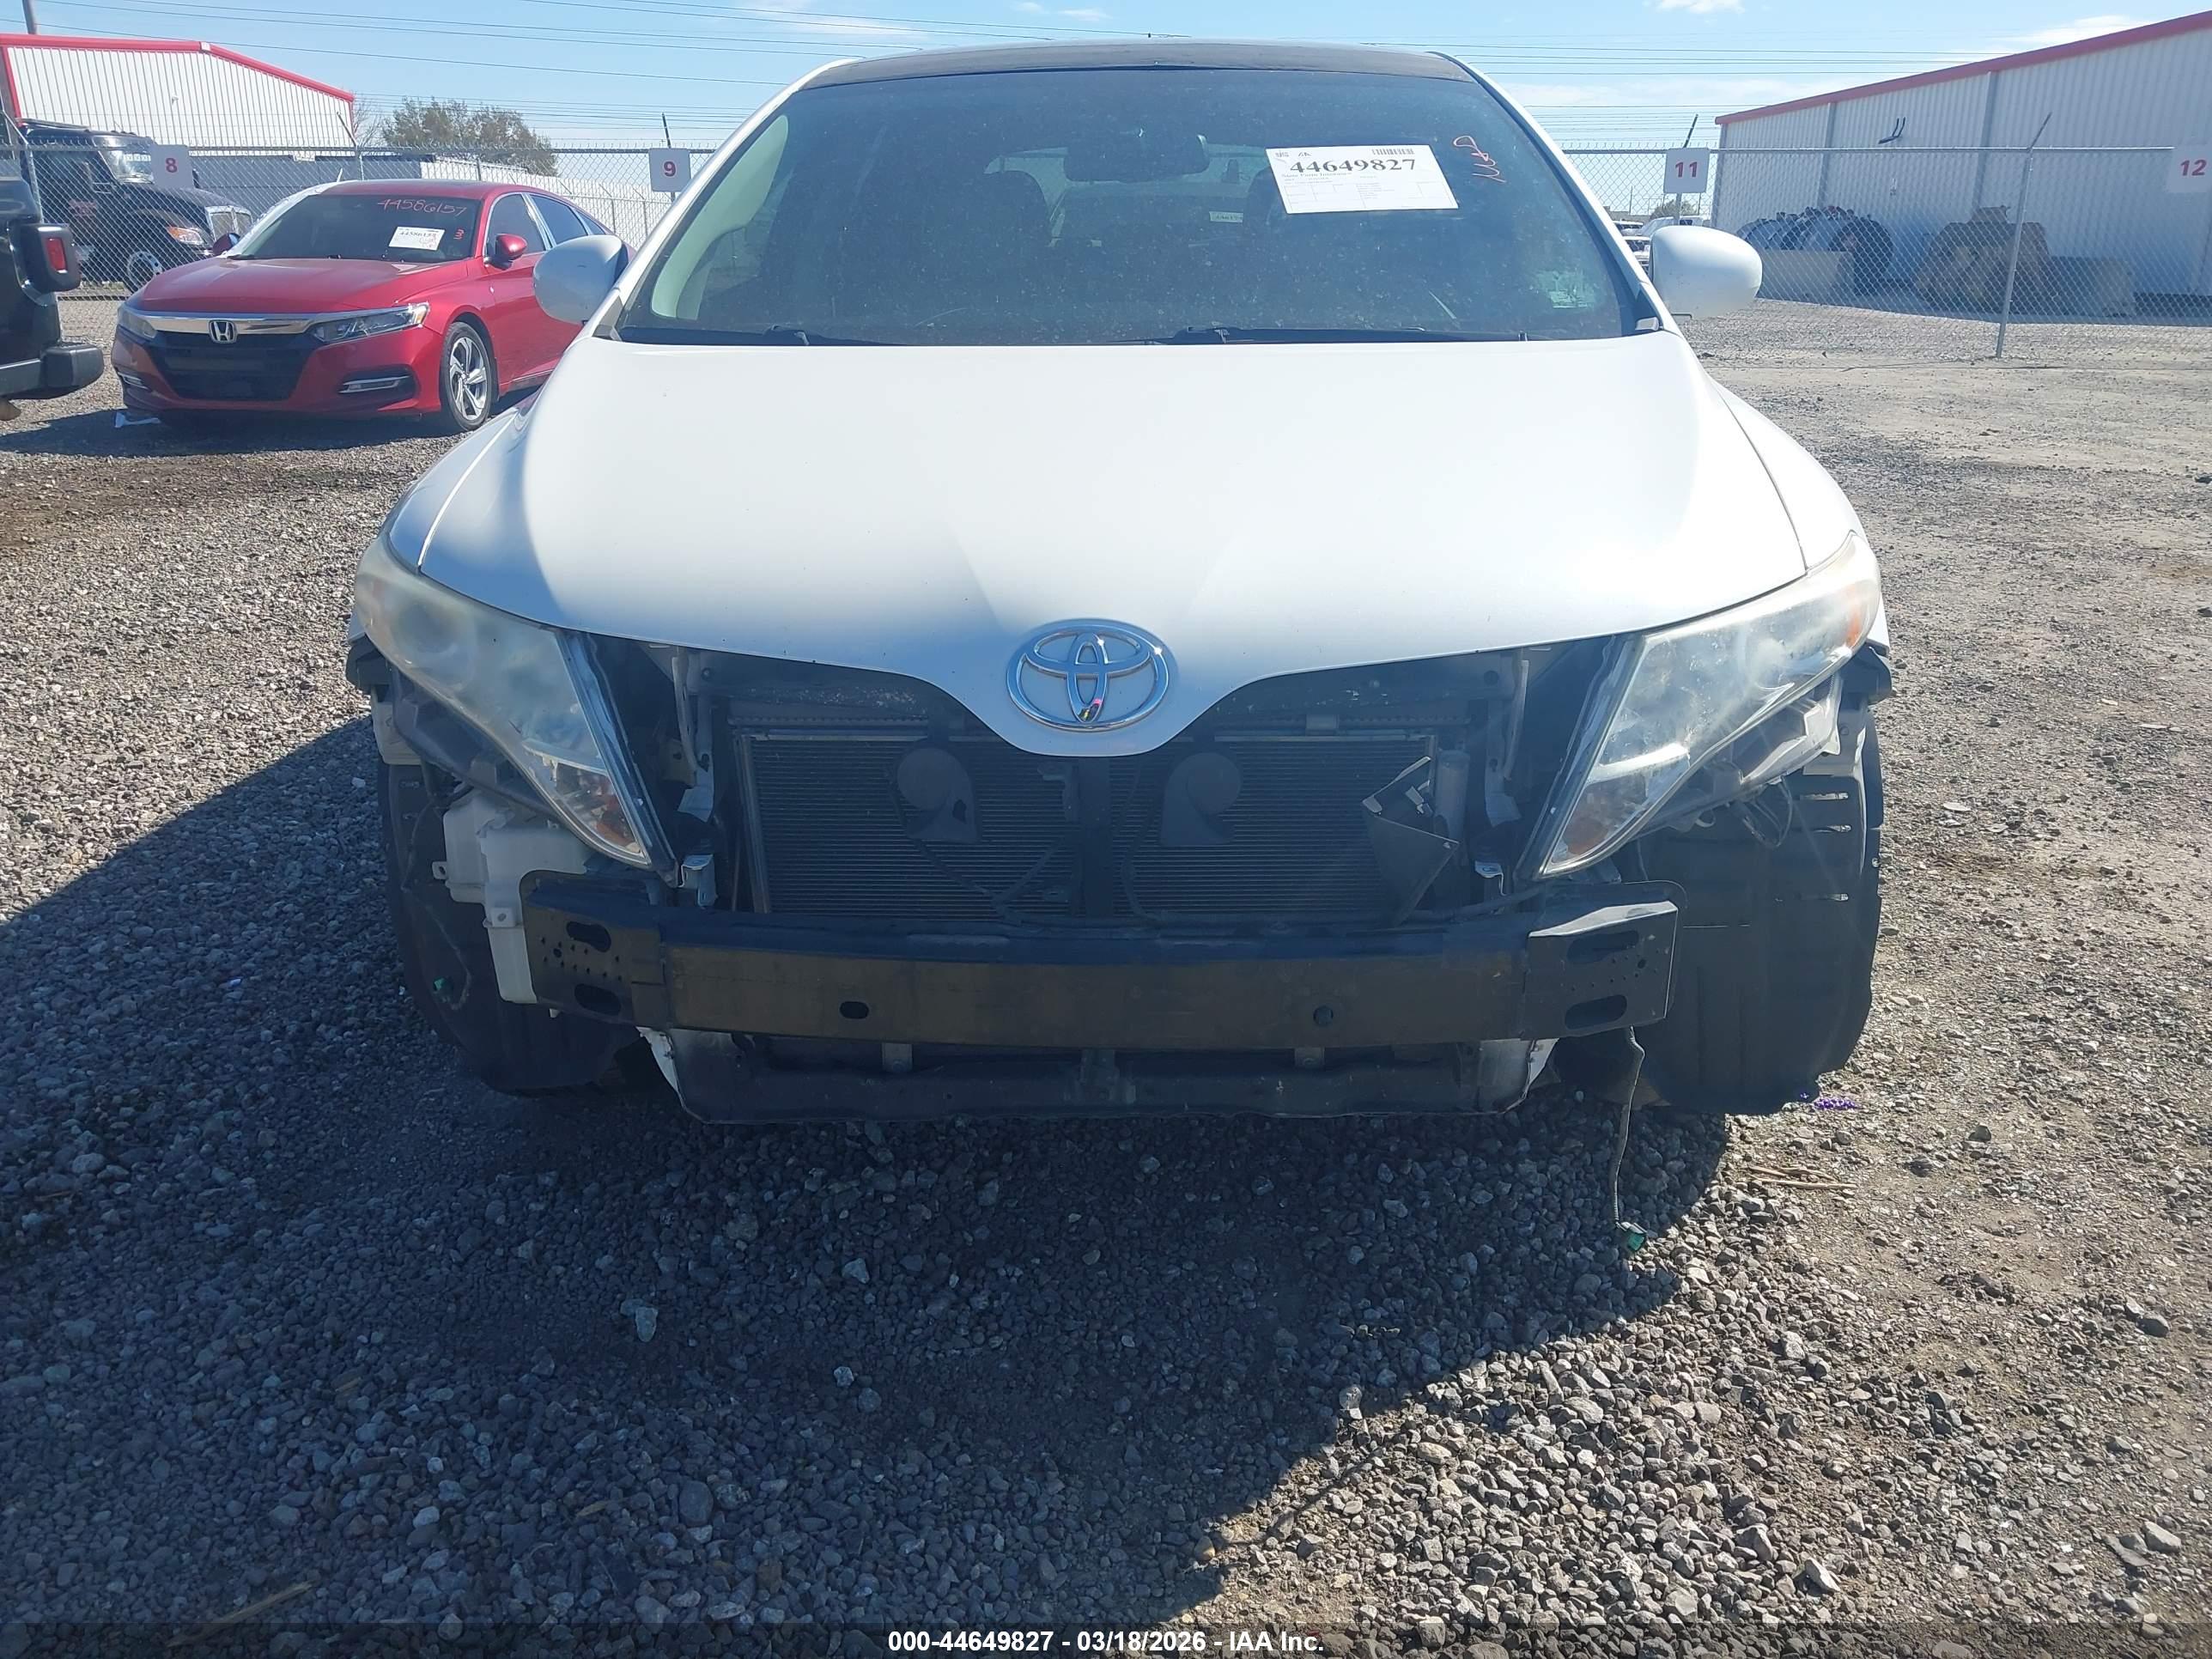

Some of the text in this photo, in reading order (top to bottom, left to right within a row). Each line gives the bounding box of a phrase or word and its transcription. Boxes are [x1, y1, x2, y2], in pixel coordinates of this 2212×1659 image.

[166, 158, 177, 173] 8
[664, 161, 677, 177] 9
[1290, 159, 1416, 173] 44649827
[1675, 161, 1698, 178] 11
[2180, 159, 2207, 176] 12
[378, 199, 467, 216] 44586157
